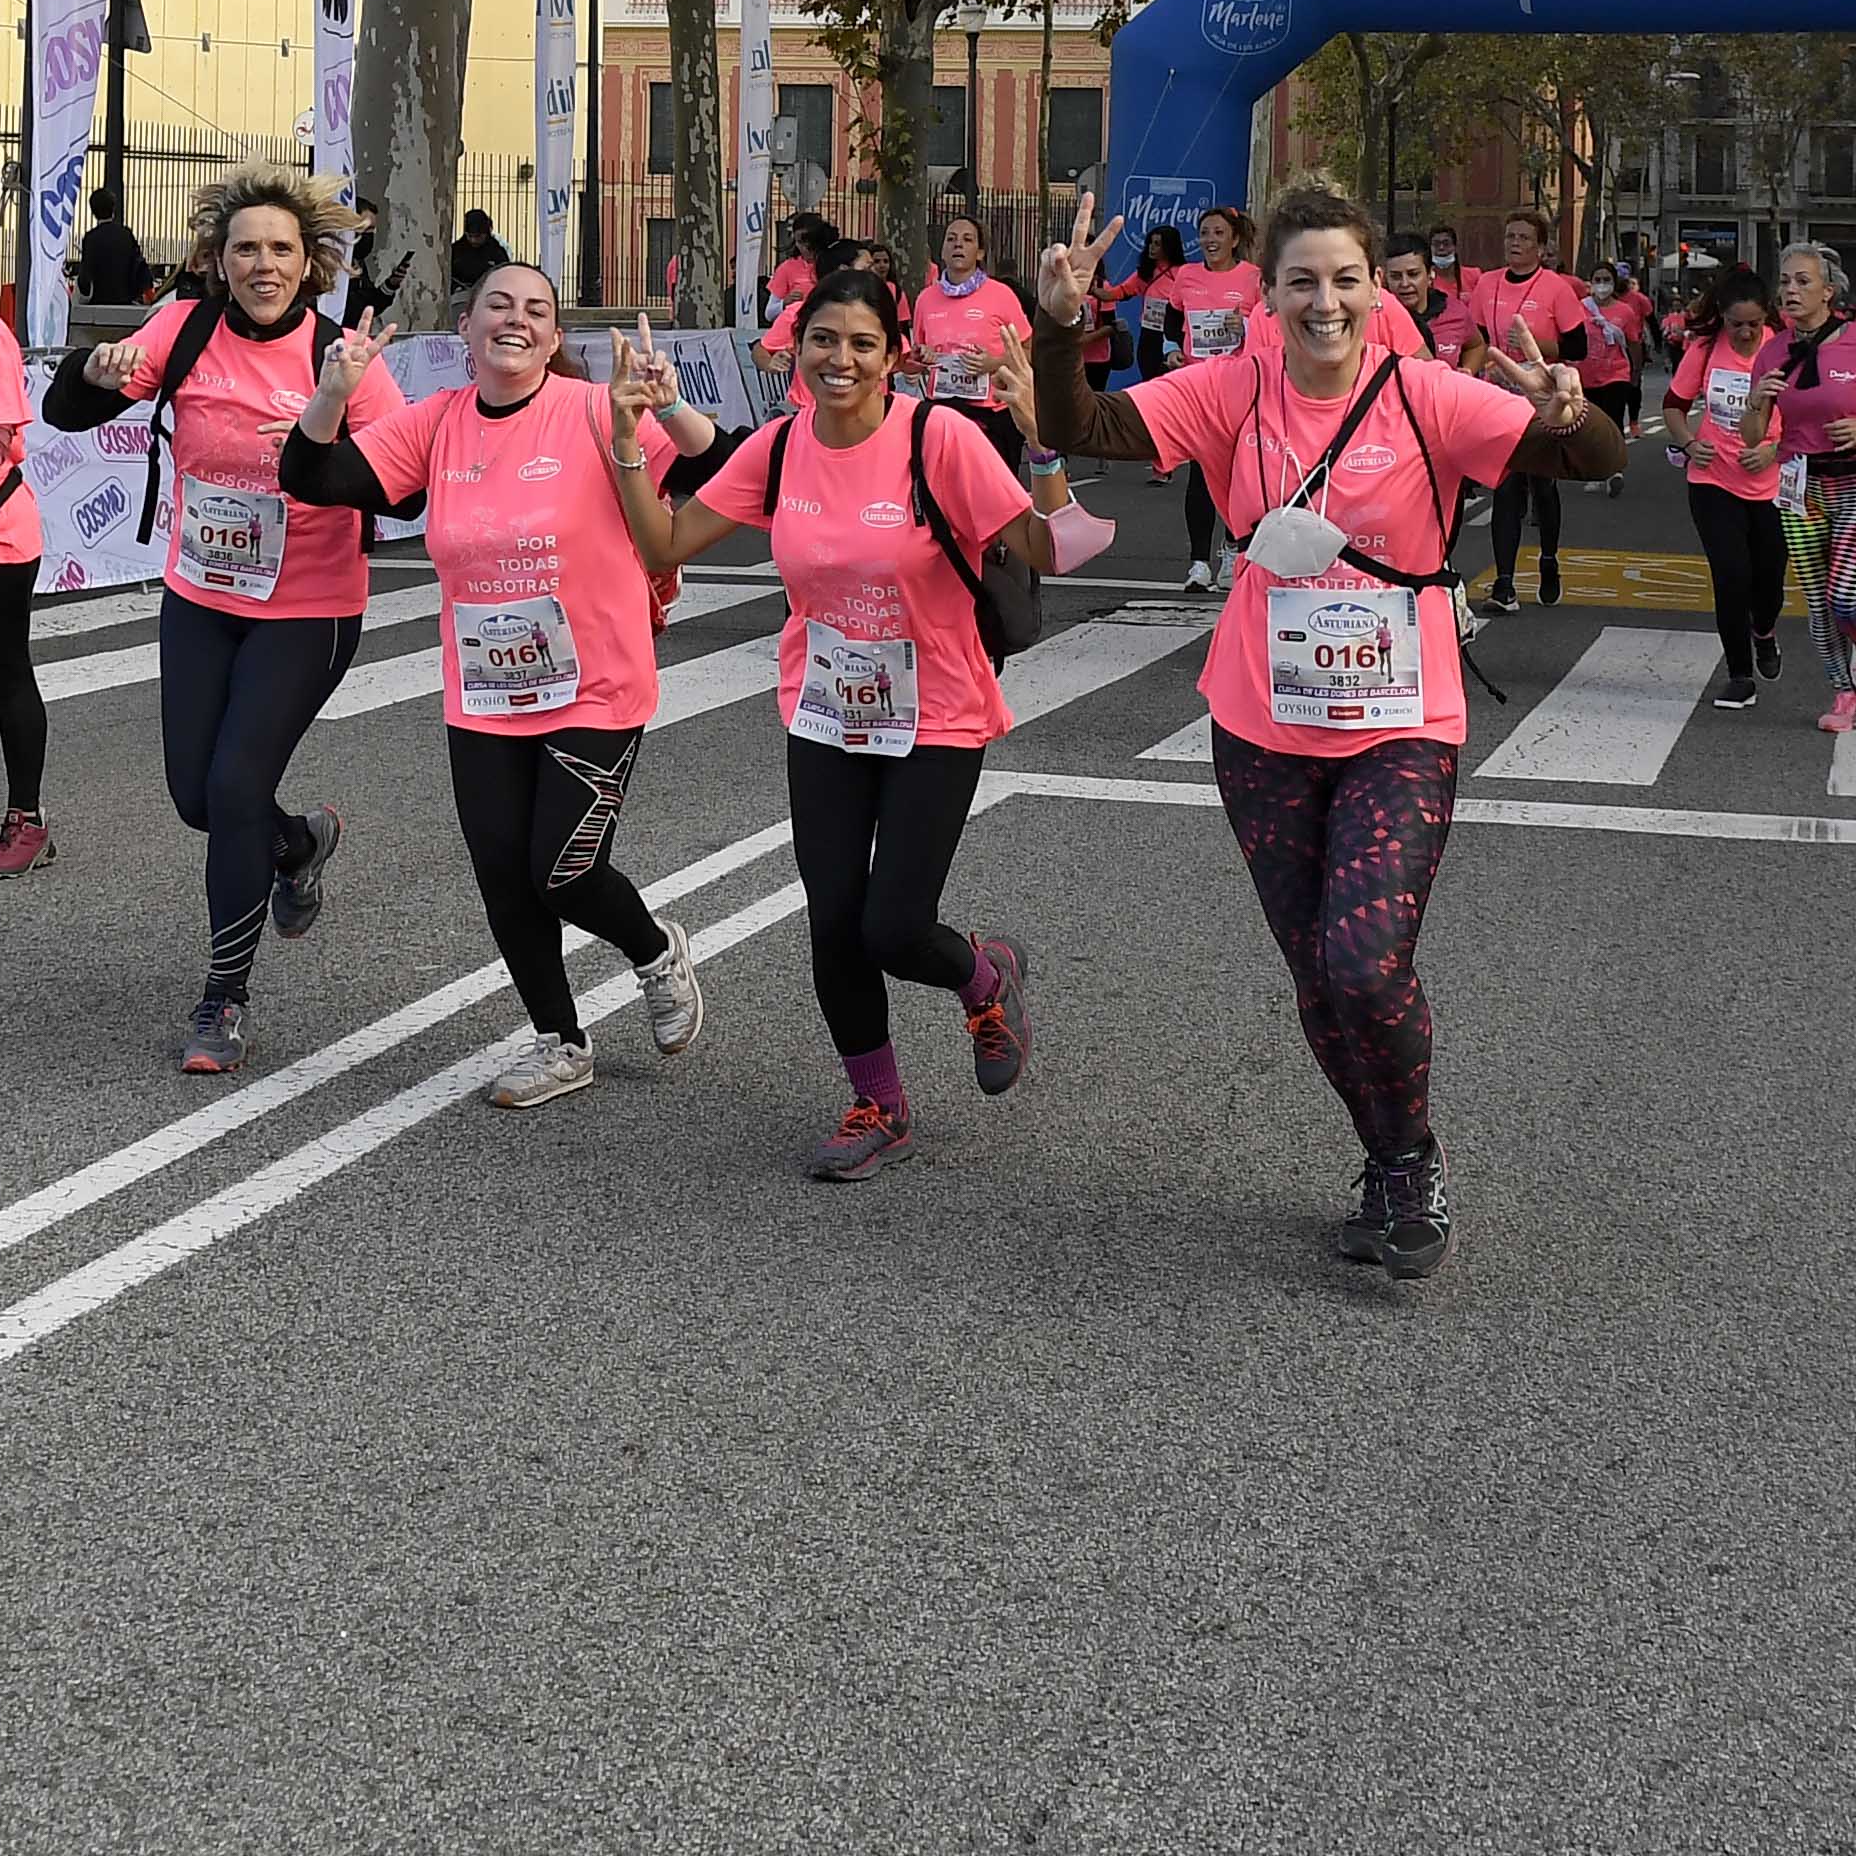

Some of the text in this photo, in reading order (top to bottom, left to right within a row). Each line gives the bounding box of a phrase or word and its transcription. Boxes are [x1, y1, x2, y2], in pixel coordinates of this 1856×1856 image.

[1208, 1, 1284, 35] Marlene
[1128, 194, 1202, 234] Marlen
[97, 425, 151, 454] COSMO
[260, 454, 279, 468] PO
[76, 484, 125, 539] COSMO
[780, 495, 821, 515] YSHO
[200, 526, 248, 549] 016
[516, 536, 556, 551] POR
[497, 556, 559, 571] TODAS
[467, 577, 560, 594] NOSOTRAS
[861, 583, 899, 599] POR
[843, 597, 902, 620] TODAS
[483, 624, 529, 636] ASTURIANA
[820, 612, 902, 639] OSOTRAS
[1315, 615, 1375, 629] ASTURIANA
[488, 645, 537, 667] 016
[1314, 645, 1376, 669] 016
[836, 677, 876, 704] 016
[1329, 675, 1360, 687] 3832
[467, 696, 505, 706] OYSHO
[1277, 703, 1322, 716] OYSHO
[798, 718, 839, 737] OYSHO
